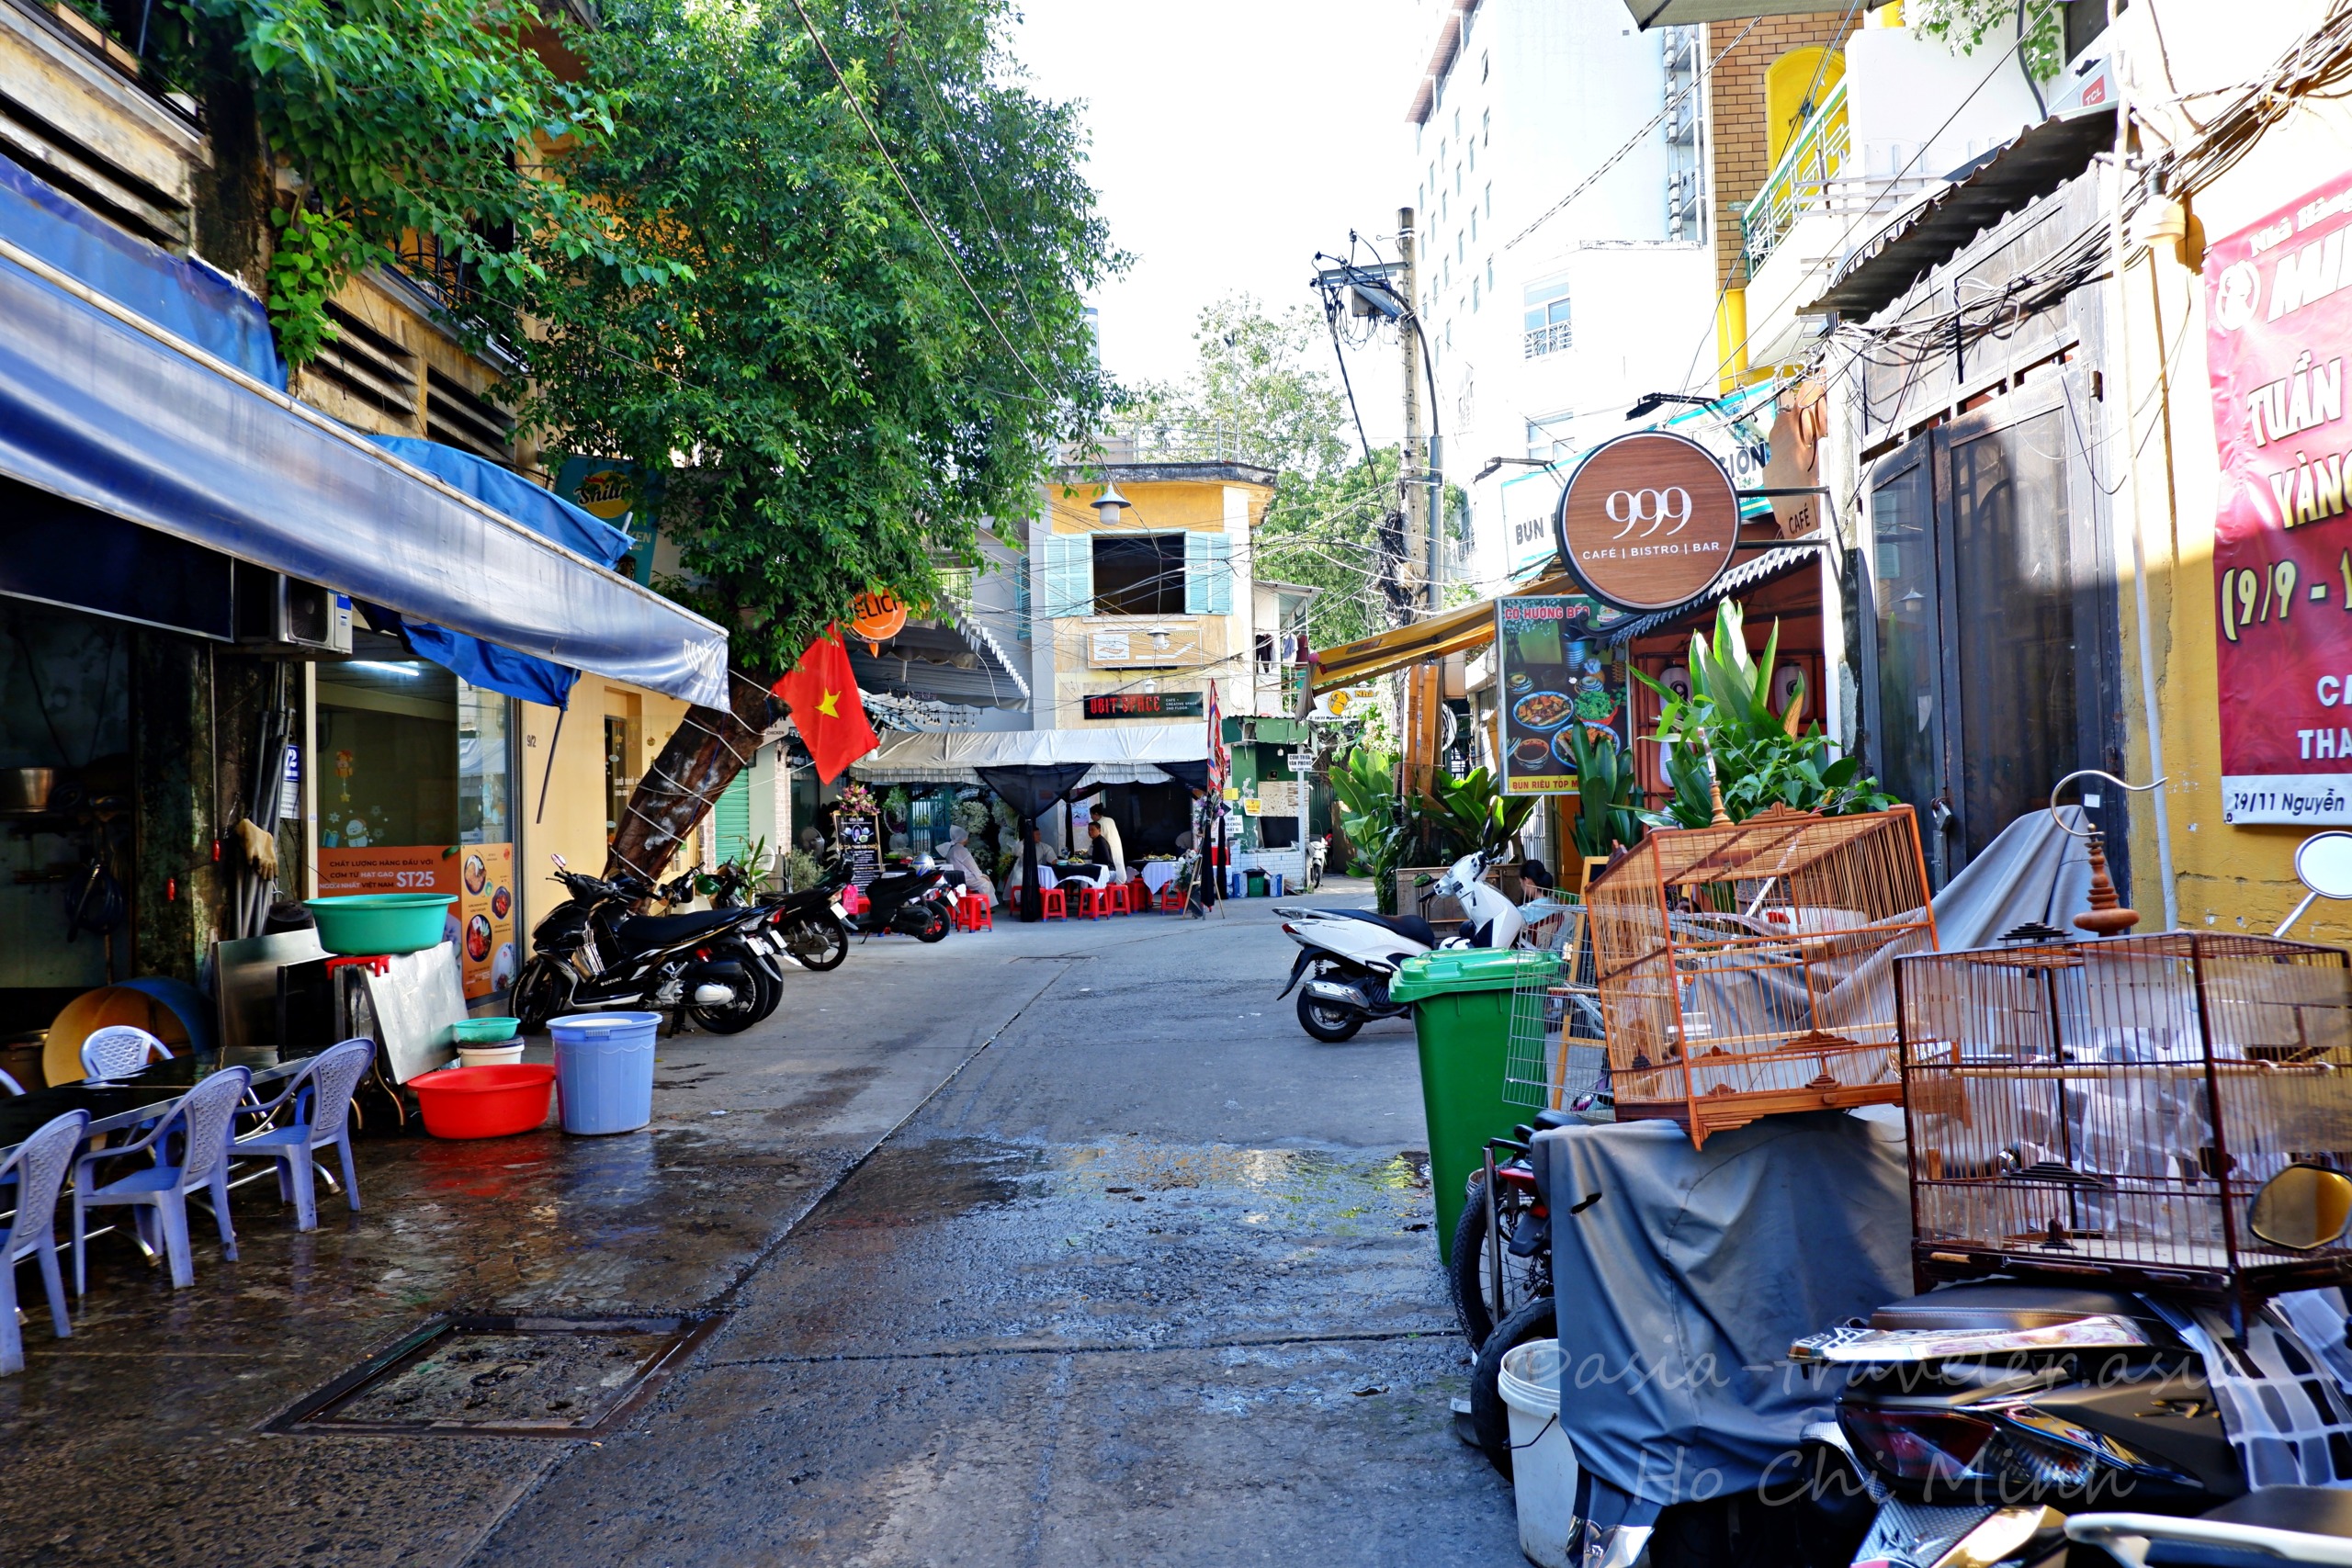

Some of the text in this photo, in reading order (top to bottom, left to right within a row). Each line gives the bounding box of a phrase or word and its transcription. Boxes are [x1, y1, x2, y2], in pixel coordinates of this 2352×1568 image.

[2086, 87, 2102, 106] TCL
[2267, 223, 2352, 324] MI
[1605, 486, 1693, 540] 999
[1788, 502, 1811, 535] CAFÉ
[1582, 547, 1617, 560] CAFÉ
[1631, 546, 1679, 557] BISTRO
[1692, 541, 1720, 552] BAR
[526, 735, 537, 748] 9/2
[1512, 779, 1529, 789] BÚN
[2282, 788, 2345, 816] Nguyễn
[351, 860, 378, 868] LƯỢNG
[396, 871, 435, 888] ST25
[600, 976, 622, 987] SUZUKI
